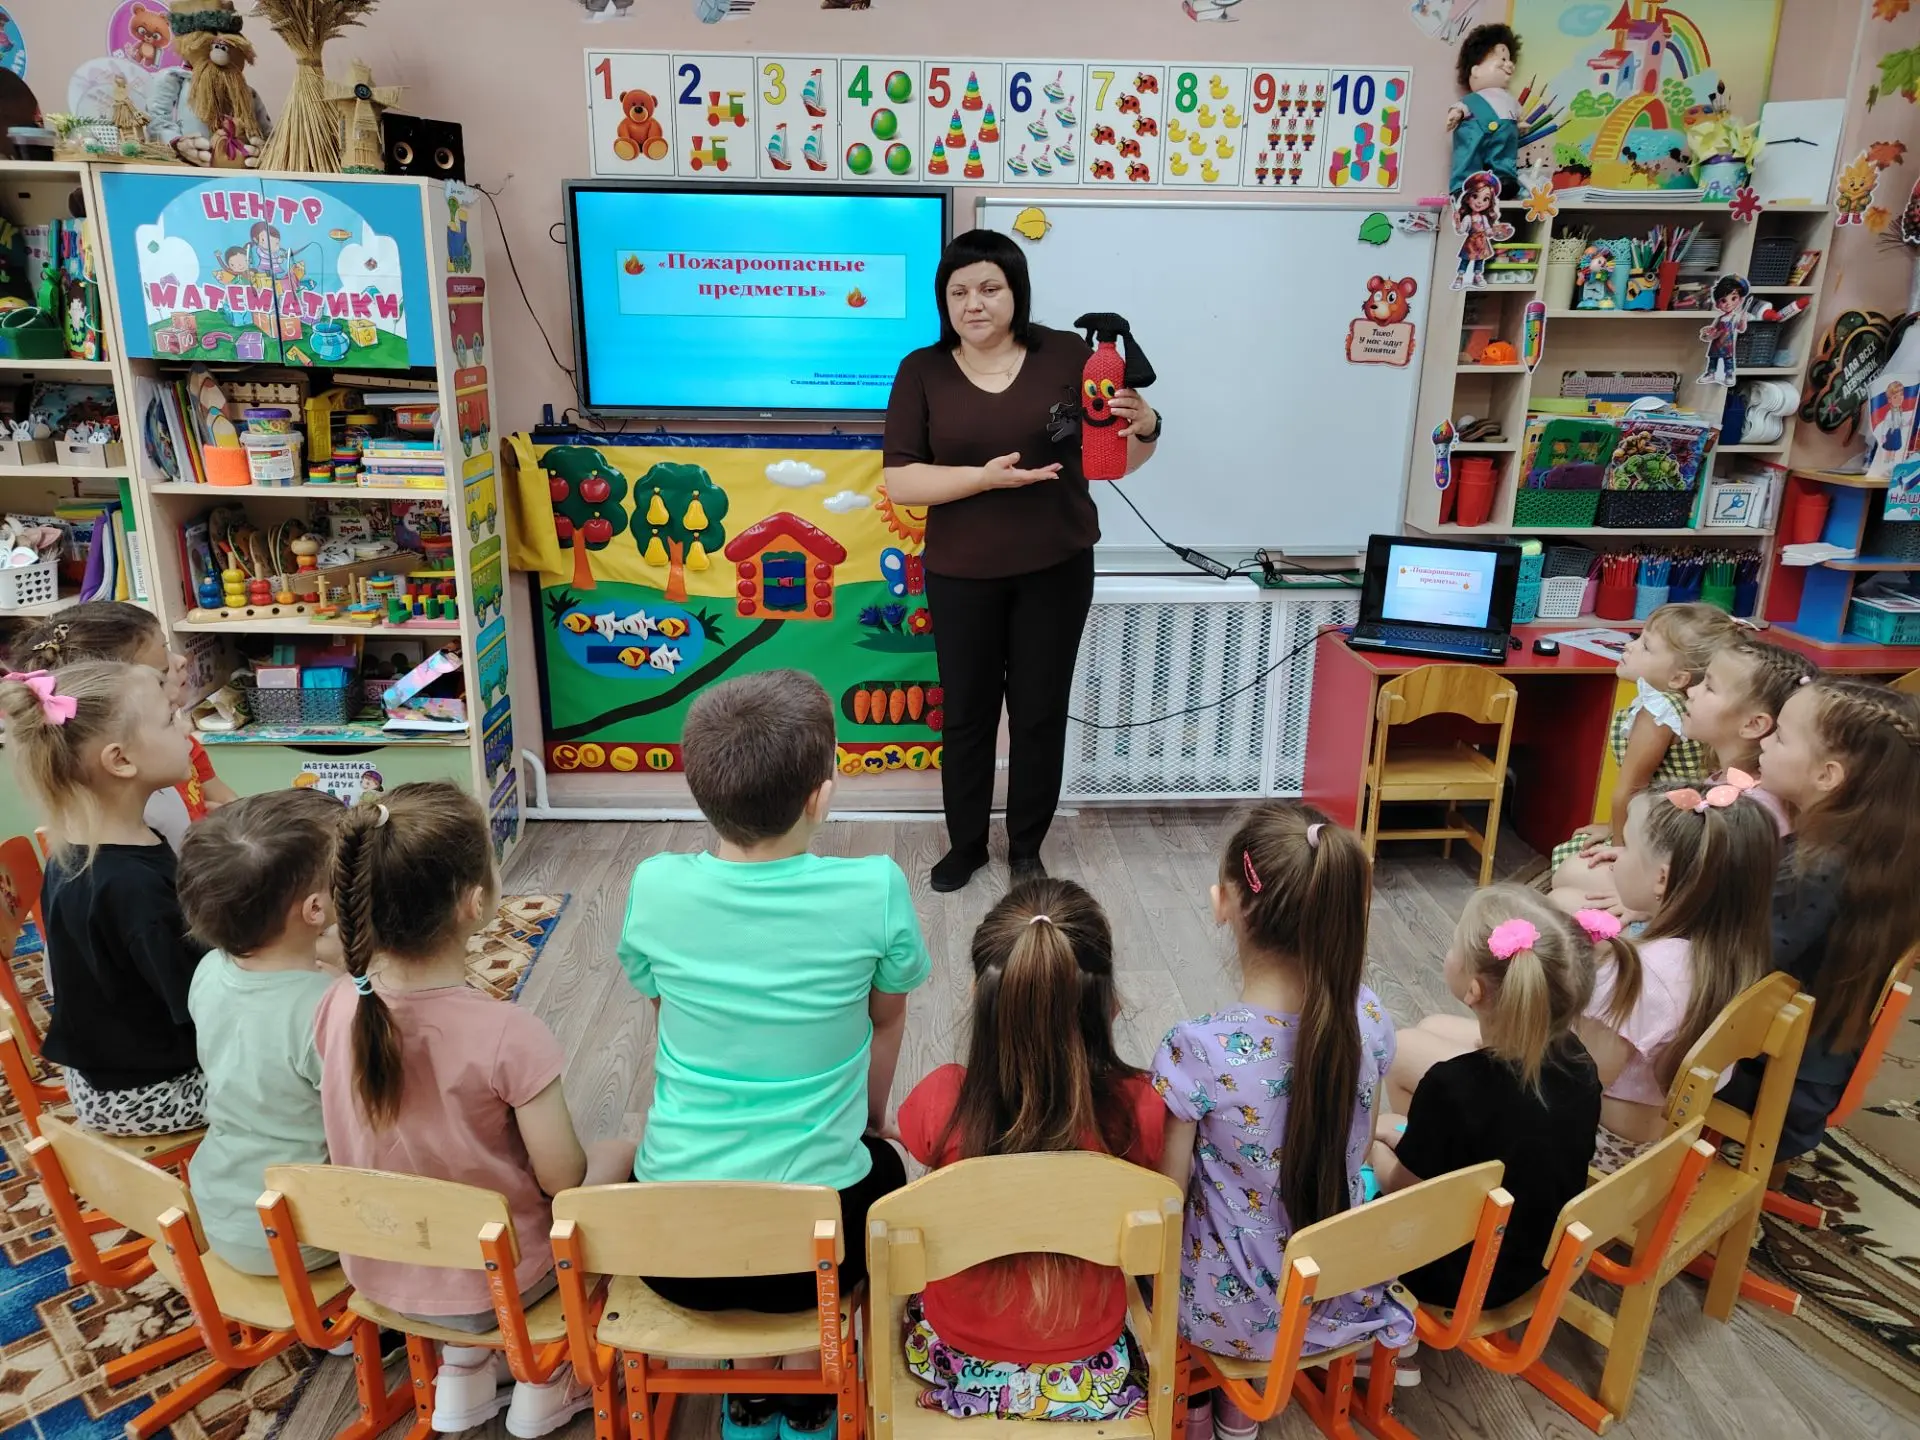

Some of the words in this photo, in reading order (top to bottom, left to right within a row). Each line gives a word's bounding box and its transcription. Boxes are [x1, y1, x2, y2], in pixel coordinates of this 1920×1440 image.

[594, 58, 613, 100] 1
[678, 63, 702, 105] 2
[763, 63, 786, 105] 3
[847, 64, 873, 106] 4
[928, 67, 951, 108] 5
[1009, 72, 1032, 113] 6
[1091, 71, 1115, 112] 7
[1175, 72, 1198, 113] 8
[1253, 73, 1276, 114] 9
[1332, 74, 1376, 115] 10
[202, 191, 323, 225] ЦЕНТР
[658, 252, 866, 275] «Пожароопасные
[698, 281, 827, 300] предметы»
[148, 282, 400, 319] МАТЕМАТИКИ
[285, 321, 296, 337] 5
[1372, 328, 1395, 338] Тихо!
[1359, 336, 1366, 344] У
[1383, 340, 1404, 348] идут
[1362, 347, 1397, 355] занятия
[1843, 358, 1860, 381] ДЛЯ
[1858, 340, 1878, 364] ВСЕХ
[1841, 356, 1880, 400] ДЕВЧОНОК
[303, 762, 376, 770] математика-
[319, 772, 361, 780] царица
[327, 781, 355, 789] наук
[1088, 1351, 1114, 1370] GO
